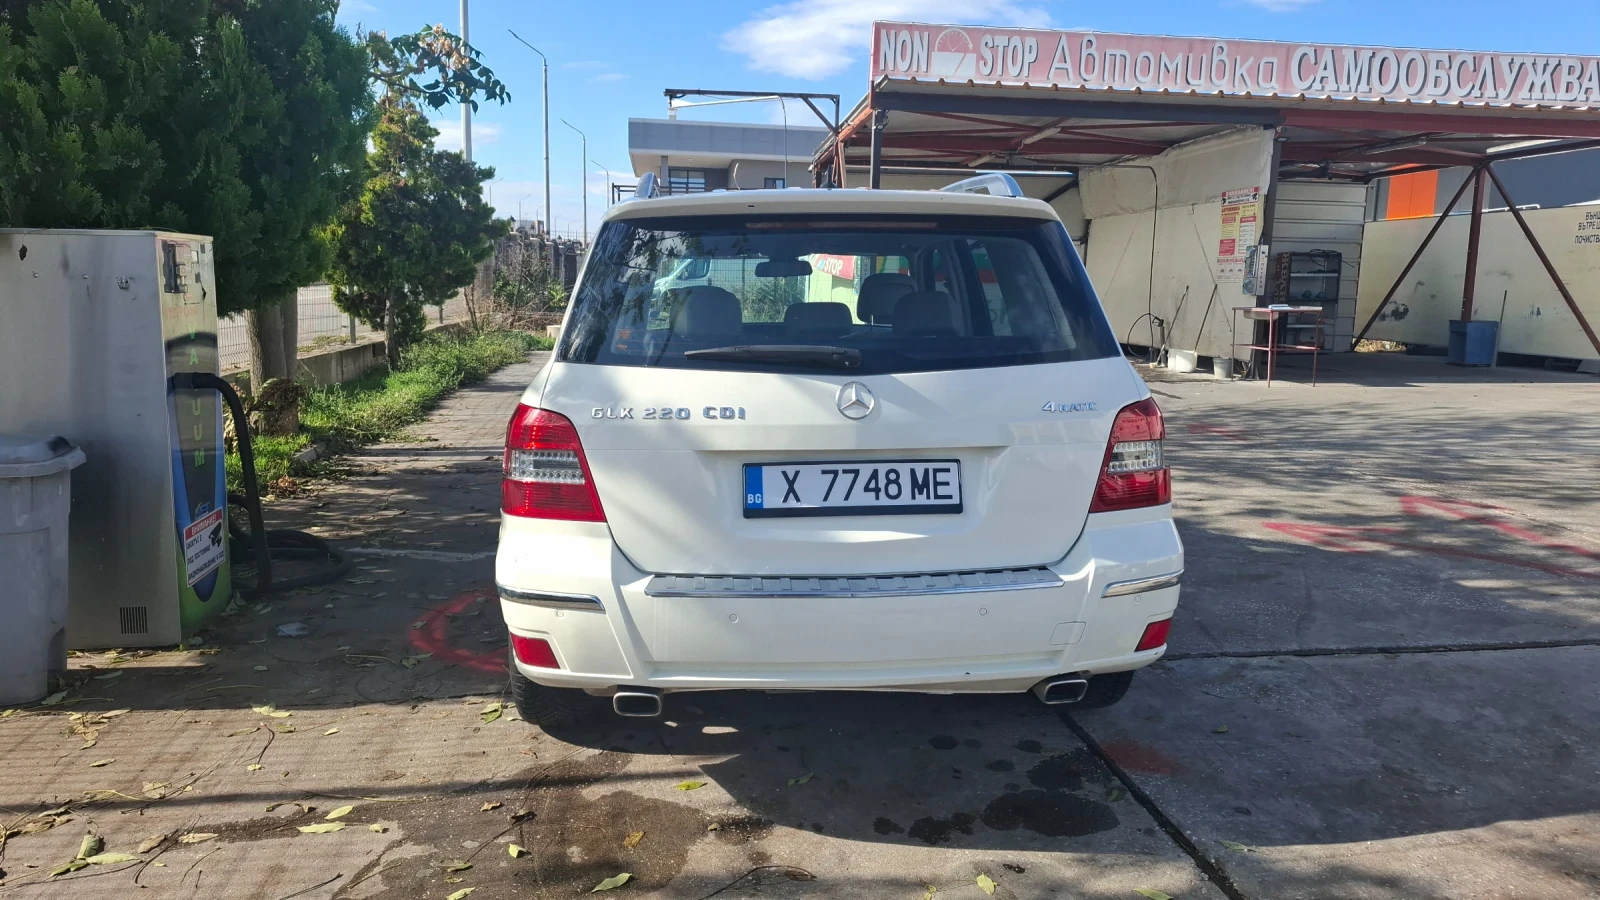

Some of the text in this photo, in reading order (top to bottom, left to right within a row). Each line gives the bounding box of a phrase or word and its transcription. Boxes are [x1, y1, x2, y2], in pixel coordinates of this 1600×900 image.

[880, 29, 1600, 103] NON STOP Автомивка САМООБСЛУЖВА
[824, 257, 843, 276] STOP
[188, 324, 205, 467] VAUUM
[591, 406, 746, 420] GLK 220 CDI
[820, 468, 902, 502] 7748
[910, 467, 953, 500] ME
[747, 493, 762, 504] BG
